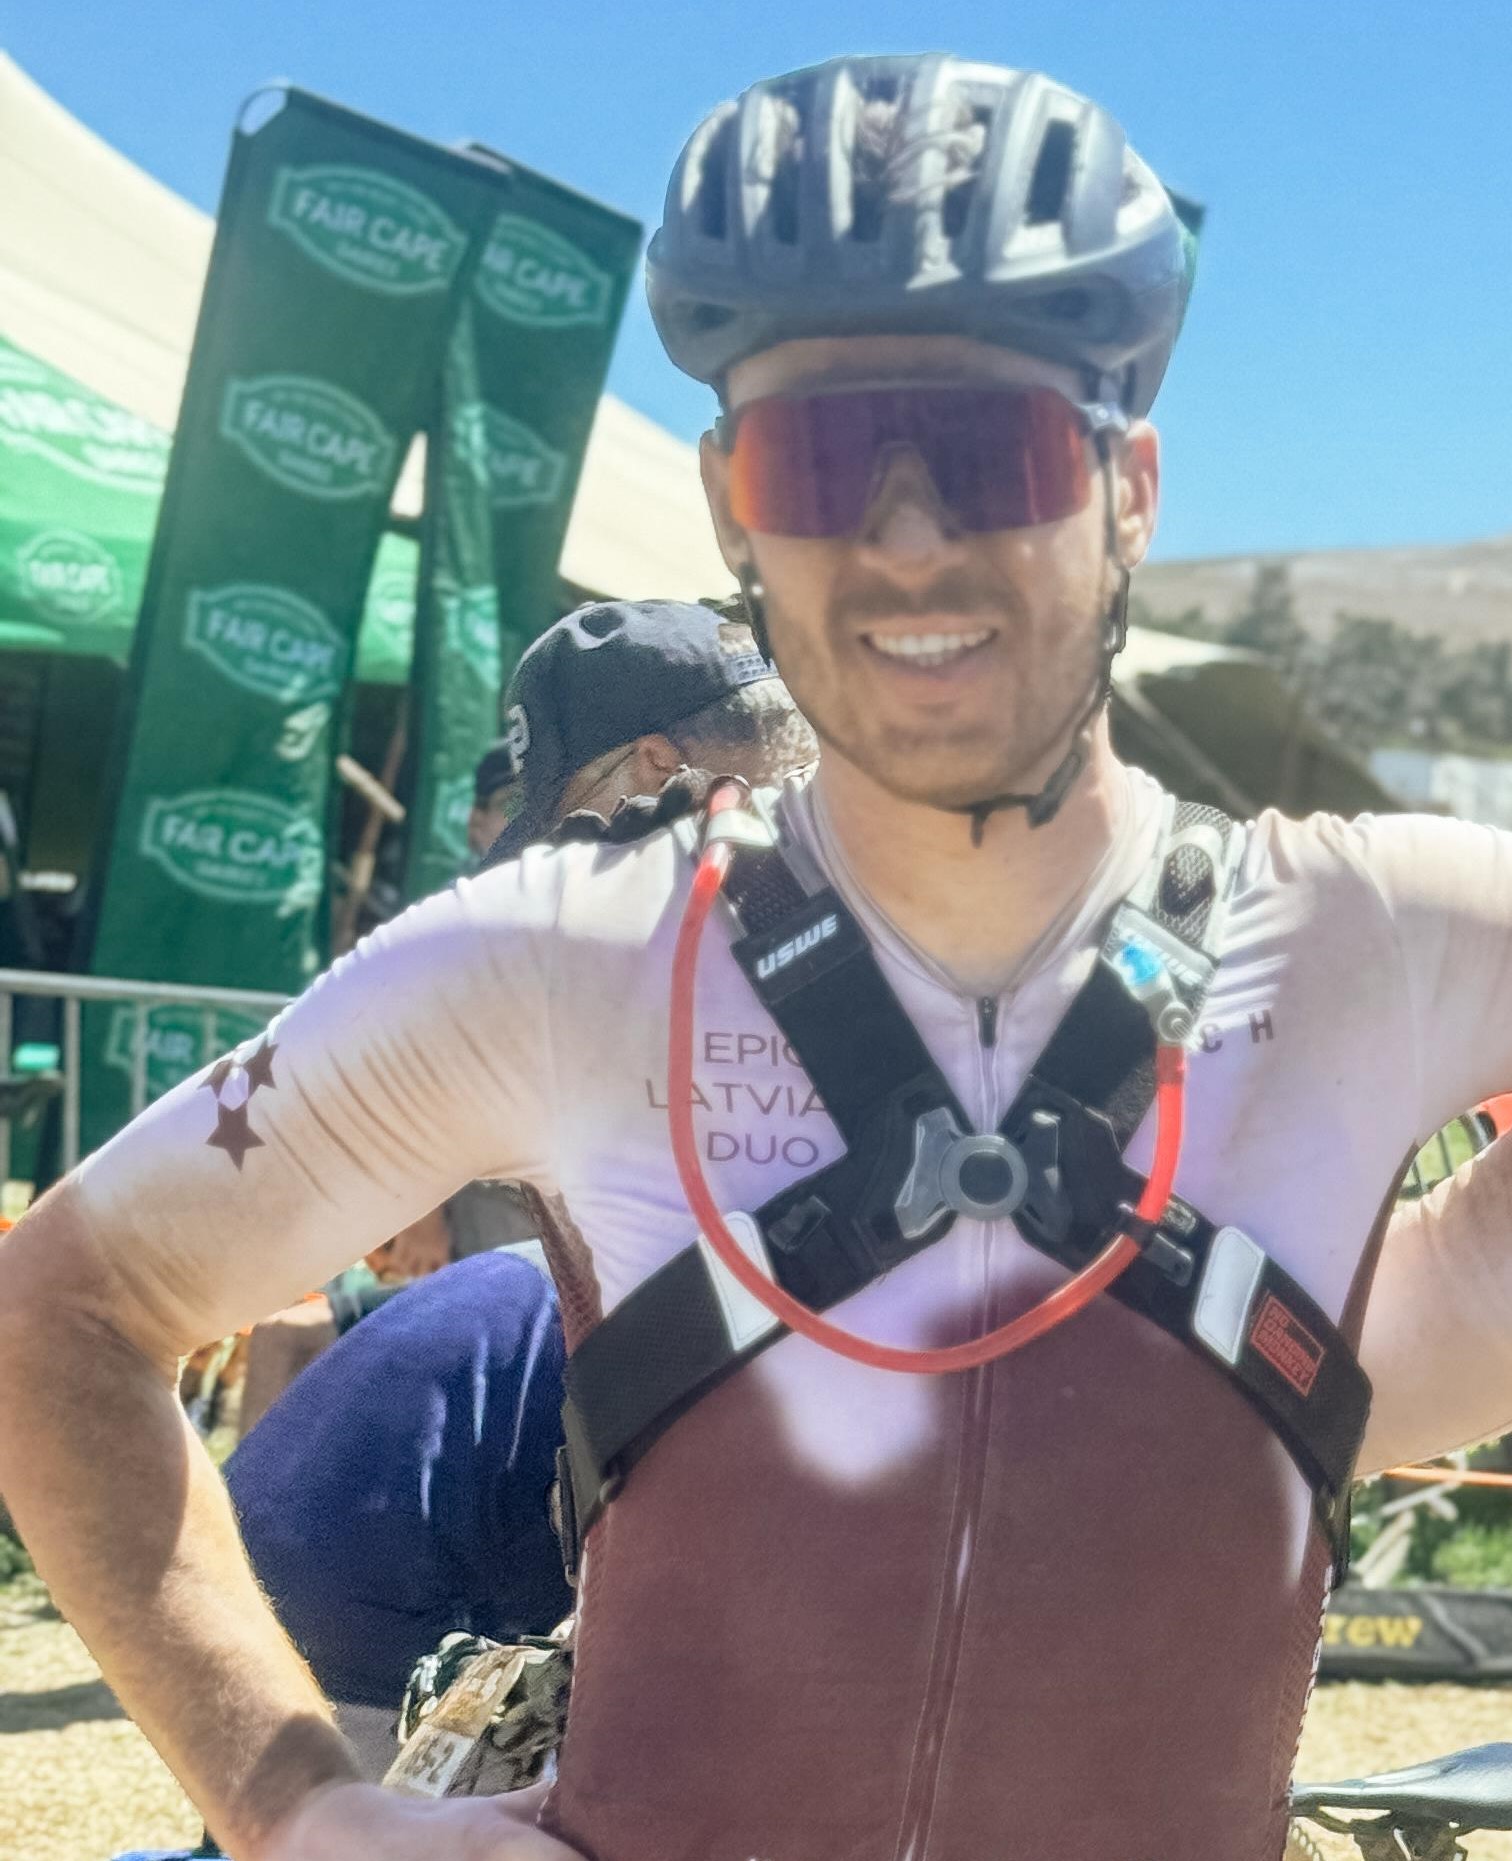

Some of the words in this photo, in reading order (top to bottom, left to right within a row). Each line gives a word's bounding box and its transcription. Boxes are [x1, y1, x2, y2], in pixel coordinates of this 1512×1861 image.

[293, 187, 366, 238] FAIR
[367, 215, 450, 273] CAPE
[514, 257, 587, 307] CAPE
[243, 399, 305, 445] FAIR
[306, 422, 379, 475] CAPE
[207, 609, 266, 653] FAIR
[268, 628, 336, 676] CAPE
[161, 813, 223, 857] FAIR
[757, 913, 838, 979] USWE
[707, 1131, 819, 1167] DUO
[1323, 1613, 1422, 1648] rew
